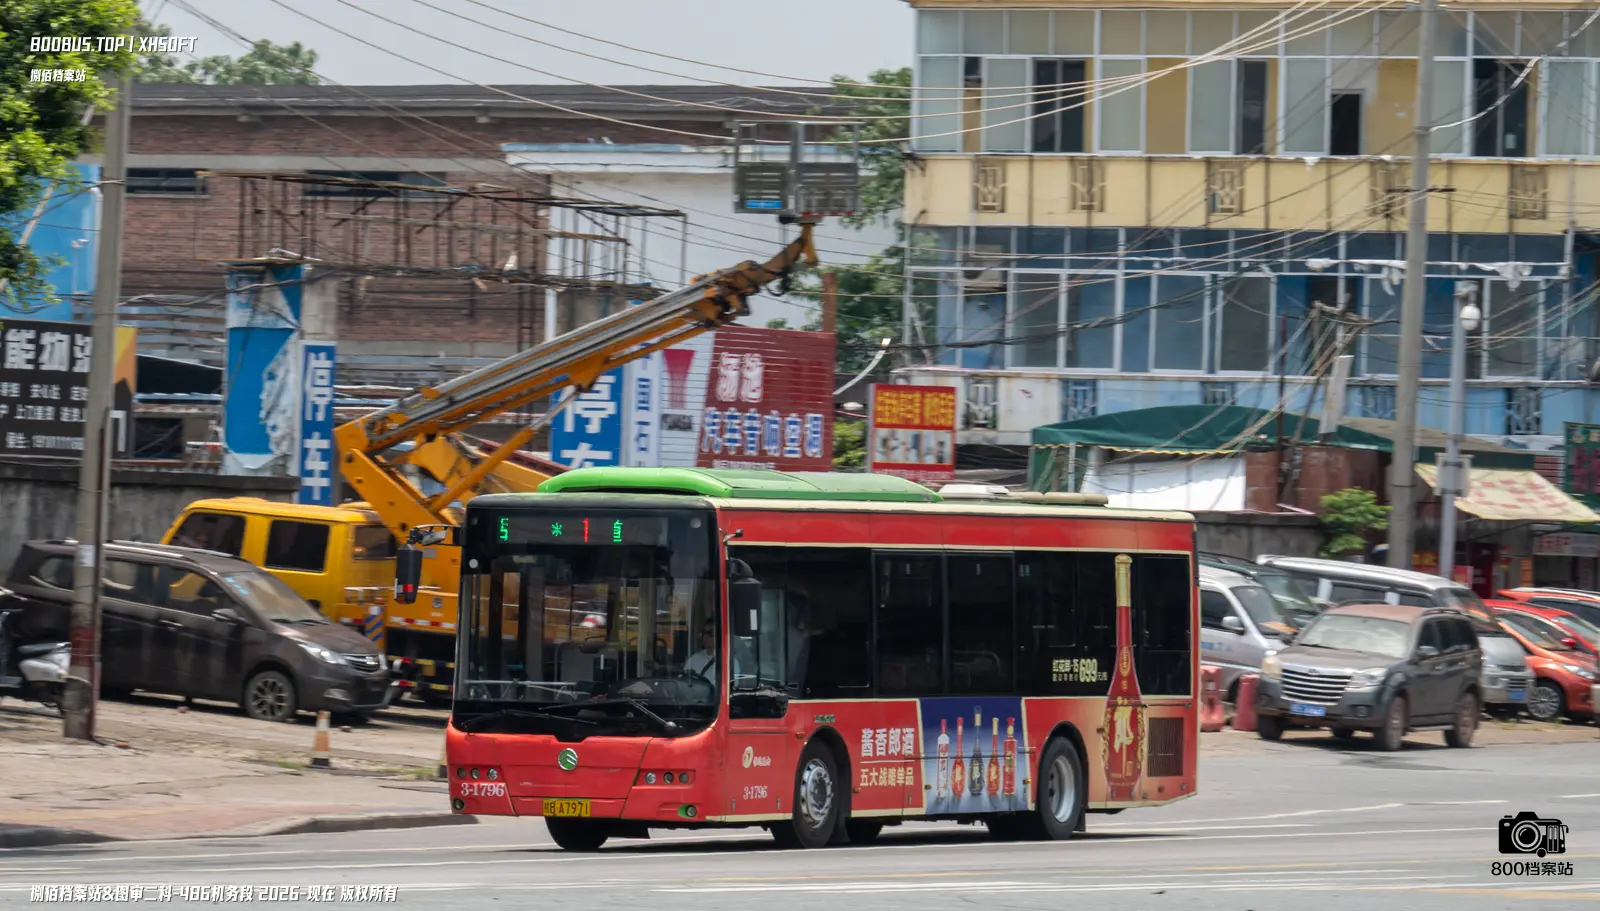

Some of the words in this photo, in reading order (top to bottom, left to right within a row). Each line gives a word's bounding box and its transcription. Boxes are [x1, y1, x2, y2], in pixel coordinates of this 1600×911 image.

[0, 328, 93, 373] 能物
[301, 352, 333, 500] 停车
[701, 407, 824, 457] 汽车音响空调
[1079, 658, 1098, 683] 699
[861, 728, 915, 757] 酱香郎酒
[461, 782, 505, 797] 3-1796
[860, 767, 914, 786] 五大战略单品
[743, 785, 768, 800] 3-1796
